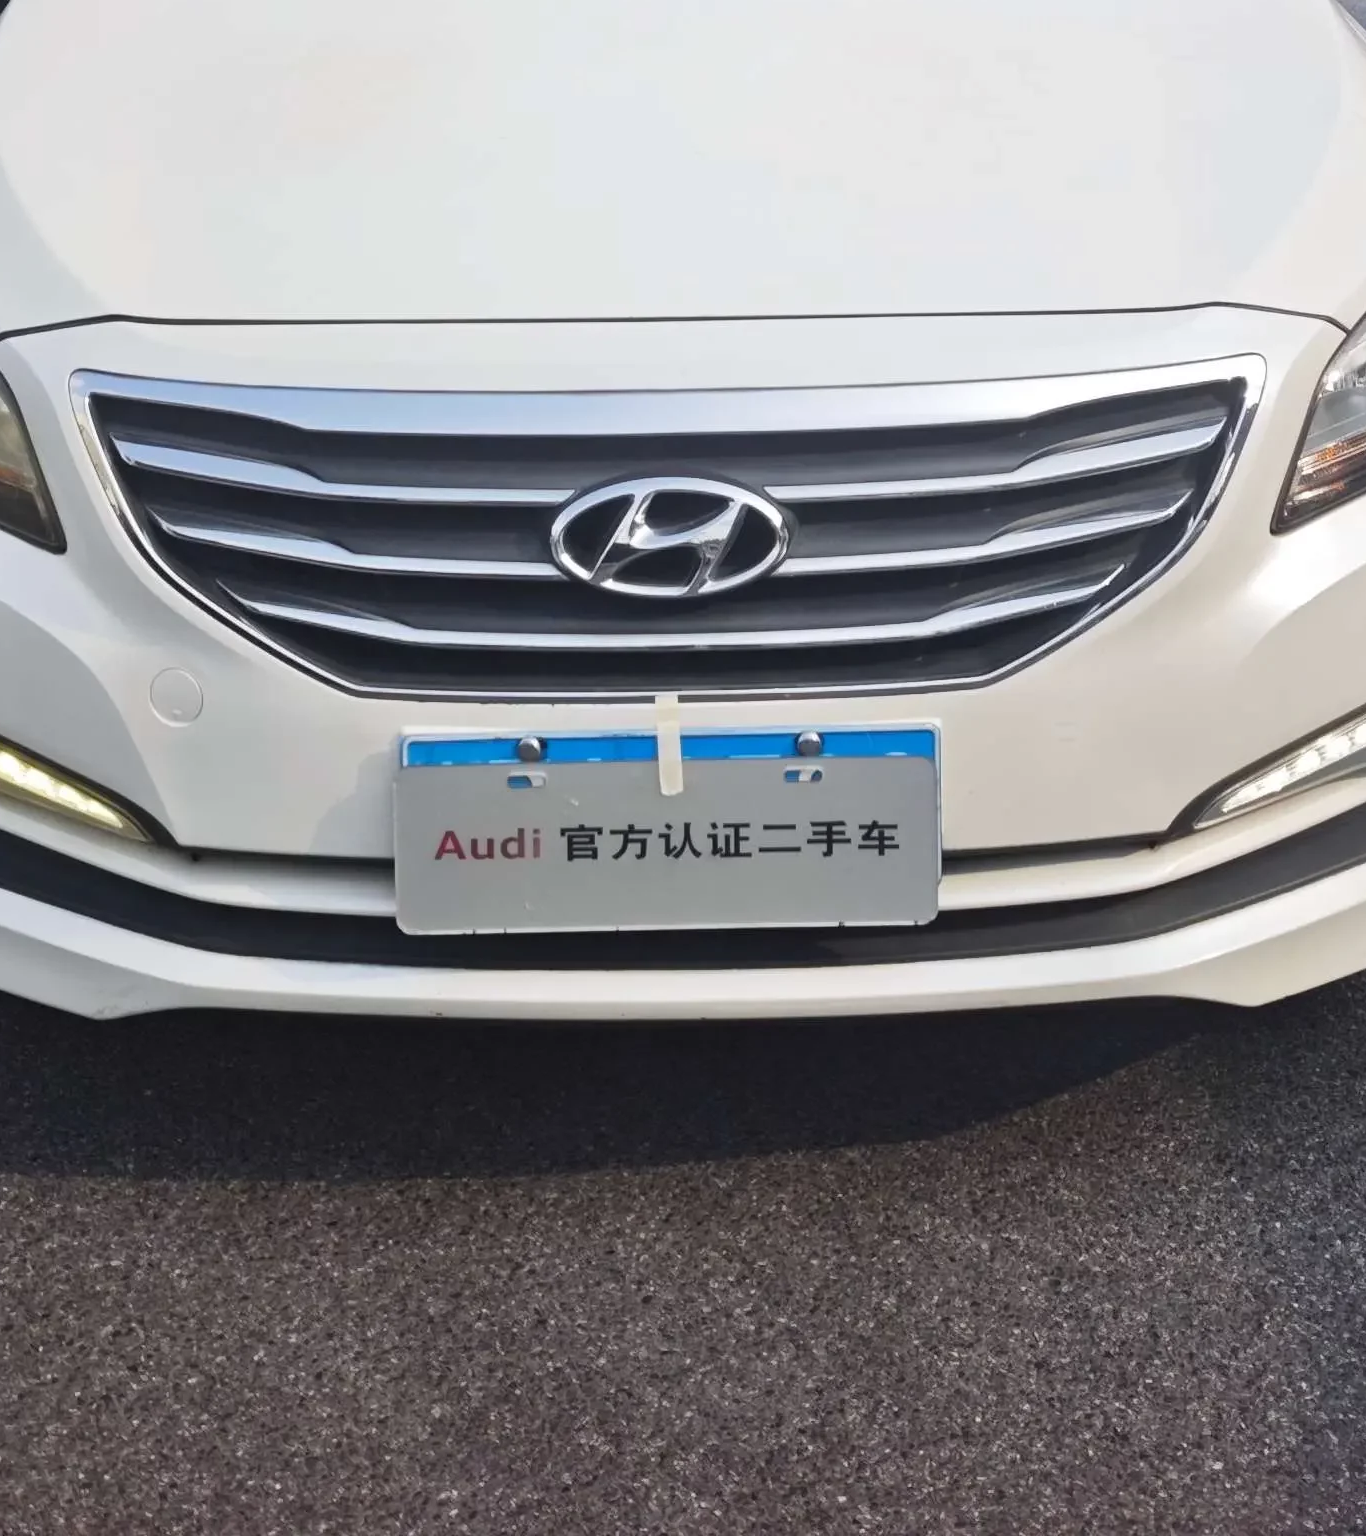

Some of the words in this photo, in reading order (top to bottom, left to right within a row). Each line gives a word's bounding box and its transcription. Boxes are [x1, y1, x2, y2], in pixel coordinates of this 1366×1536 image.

[435, 828, 543, 861] Audi
[560, 820, 901, 863] 官方认证二手车
